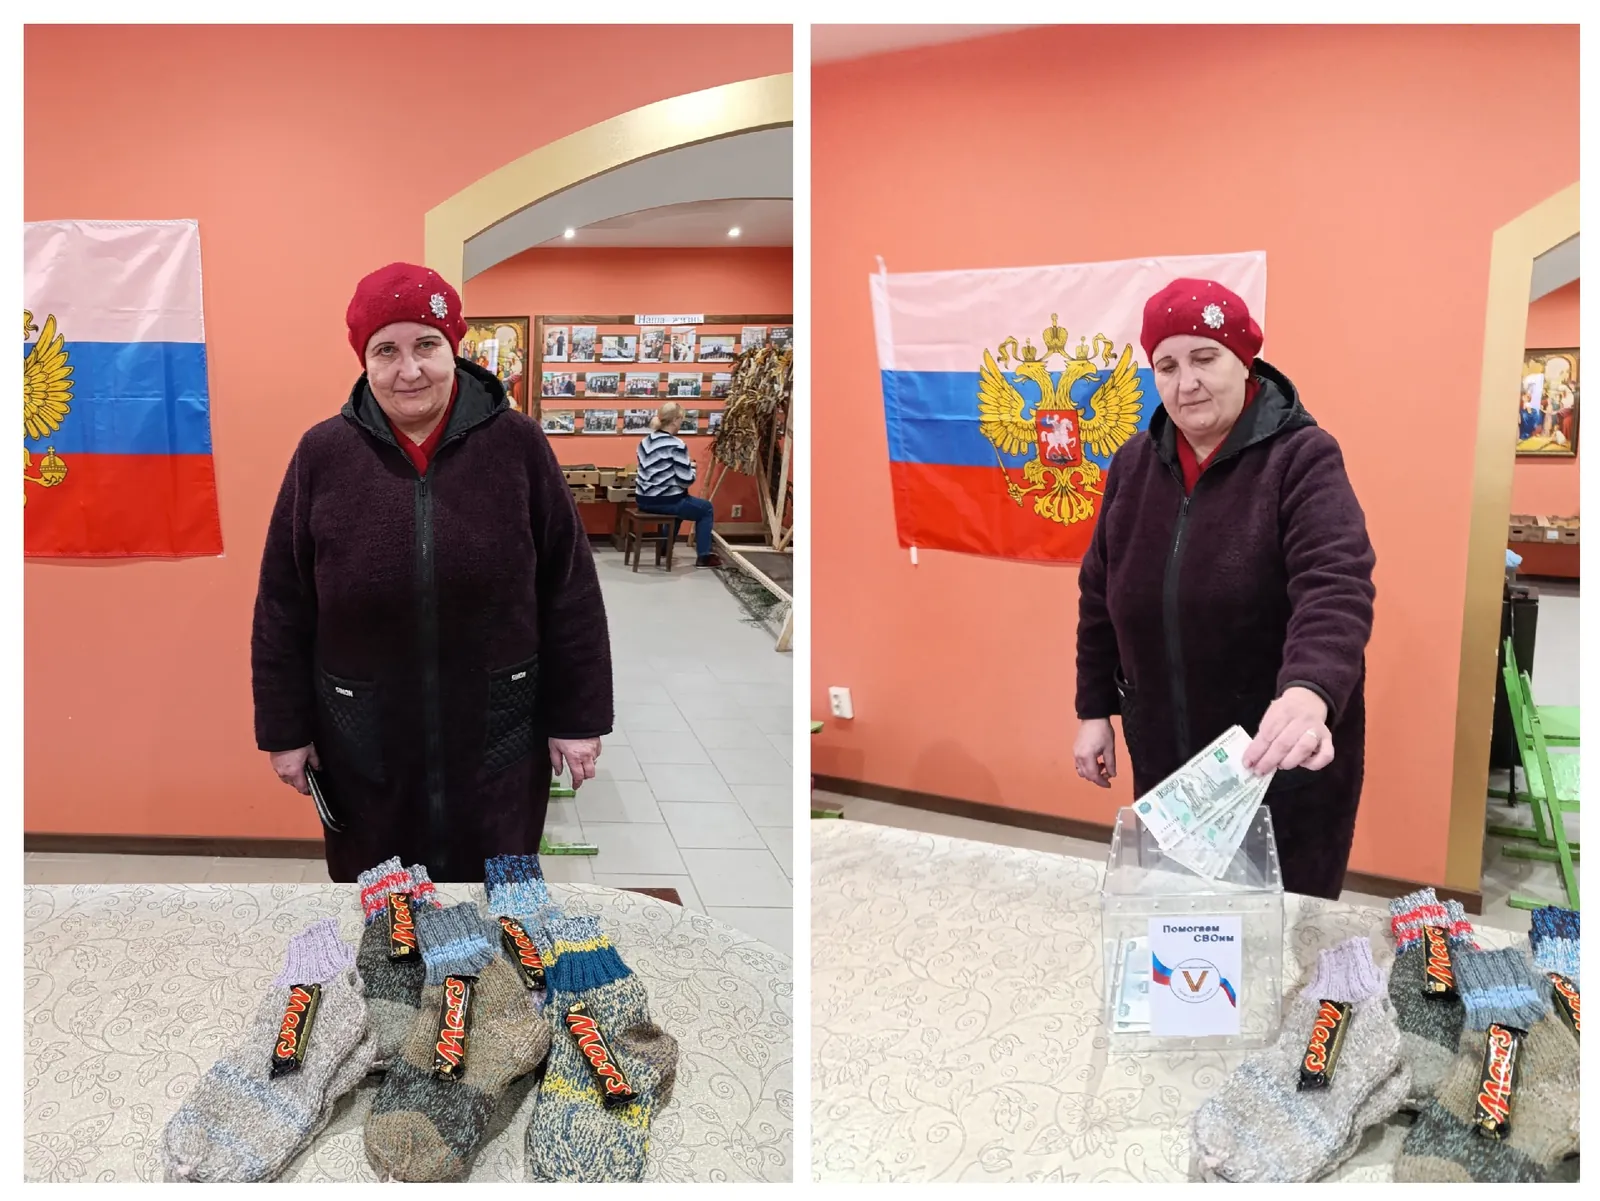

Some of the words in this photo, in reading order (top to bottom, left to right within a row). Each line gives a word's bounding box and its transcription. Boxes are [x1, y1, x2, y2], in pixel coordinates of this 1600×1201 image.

[638, 315, 665, 324] Наша
[1162, 925, 1220, 933] Помогаем
[1193, 934, 1235, 943] СВОим
[276, 986, 312, 1059] Mars
[435, 975, 466, 1066] Mars
[566, 1014, 632, 1096] Mars
[1304, 1003, 1342, 1073] Mars
[1478, 1024, 1512, 1124] Mars
